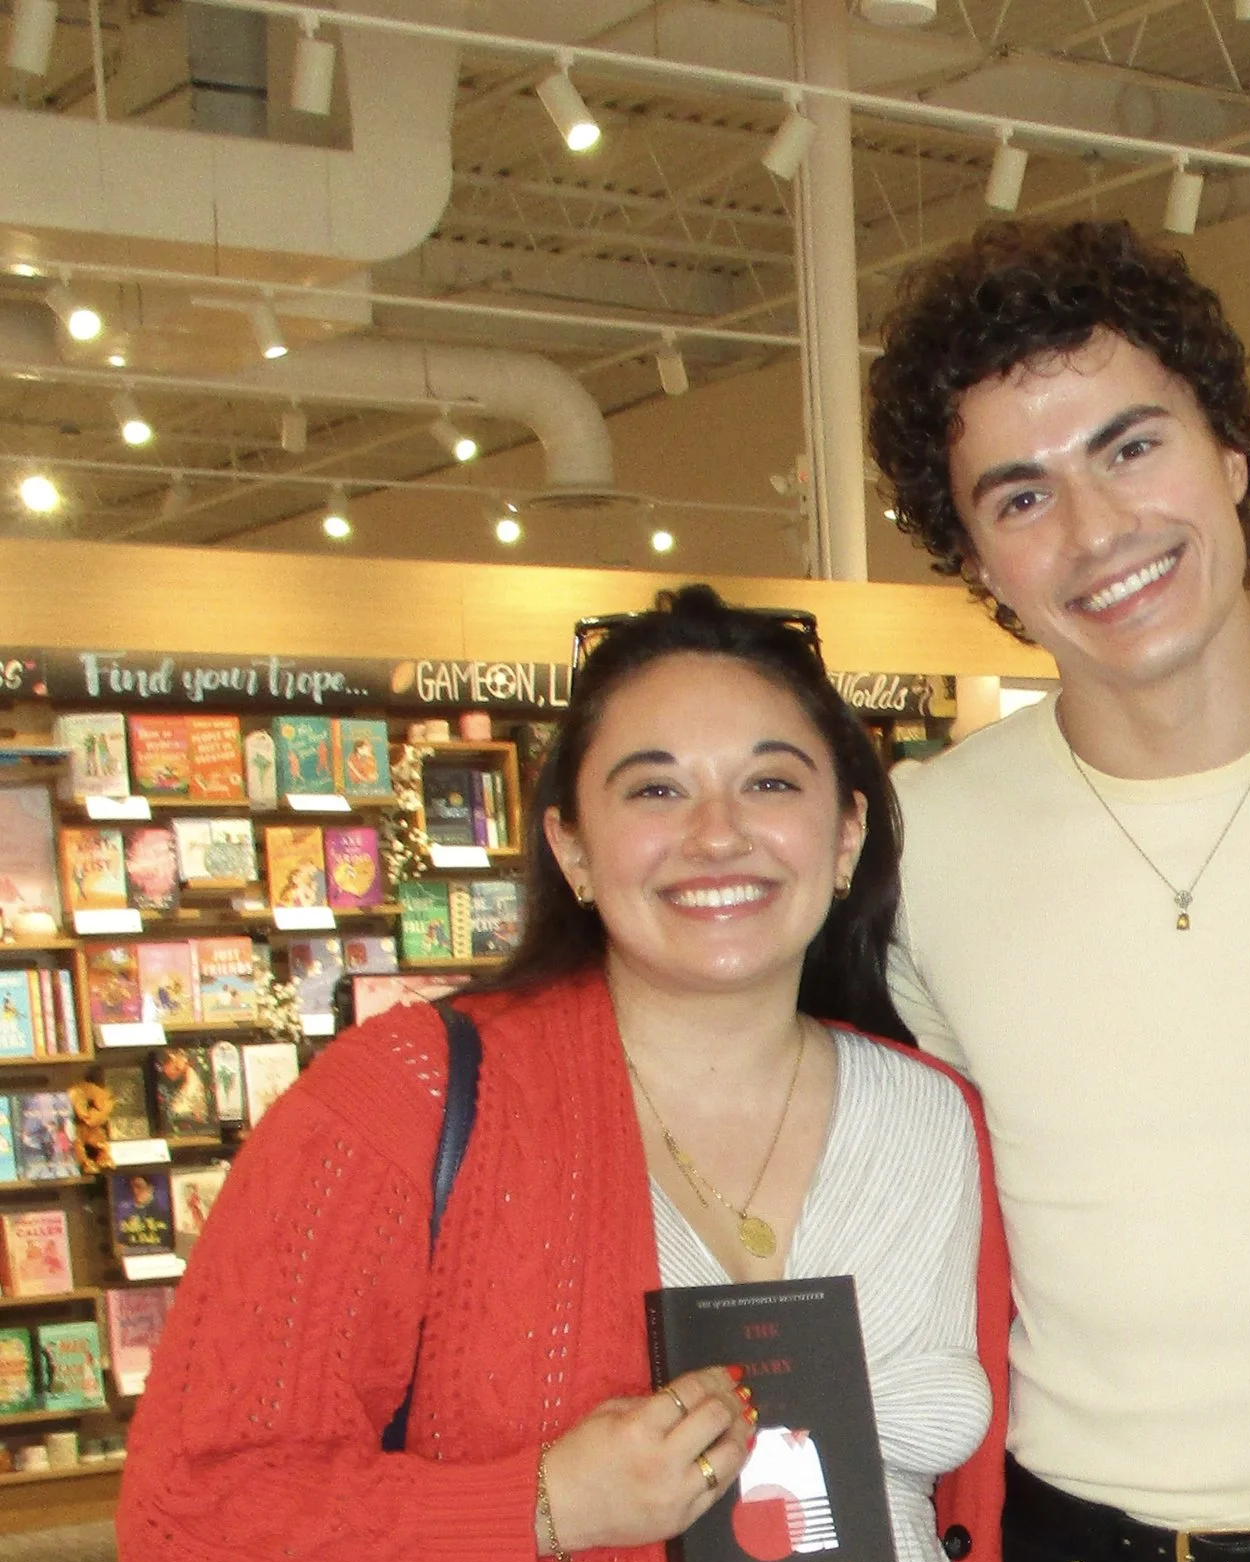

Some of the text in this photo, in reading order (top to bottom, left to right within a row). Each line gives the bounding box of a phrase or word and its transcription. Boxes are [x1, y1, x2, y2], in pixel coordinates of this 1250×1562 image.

[79, 651, 175, 698] Find
[183, 660, 257, 702] your
[417, 660, 488, 702] GAME
[832, 672, 909, 711] Worlds
